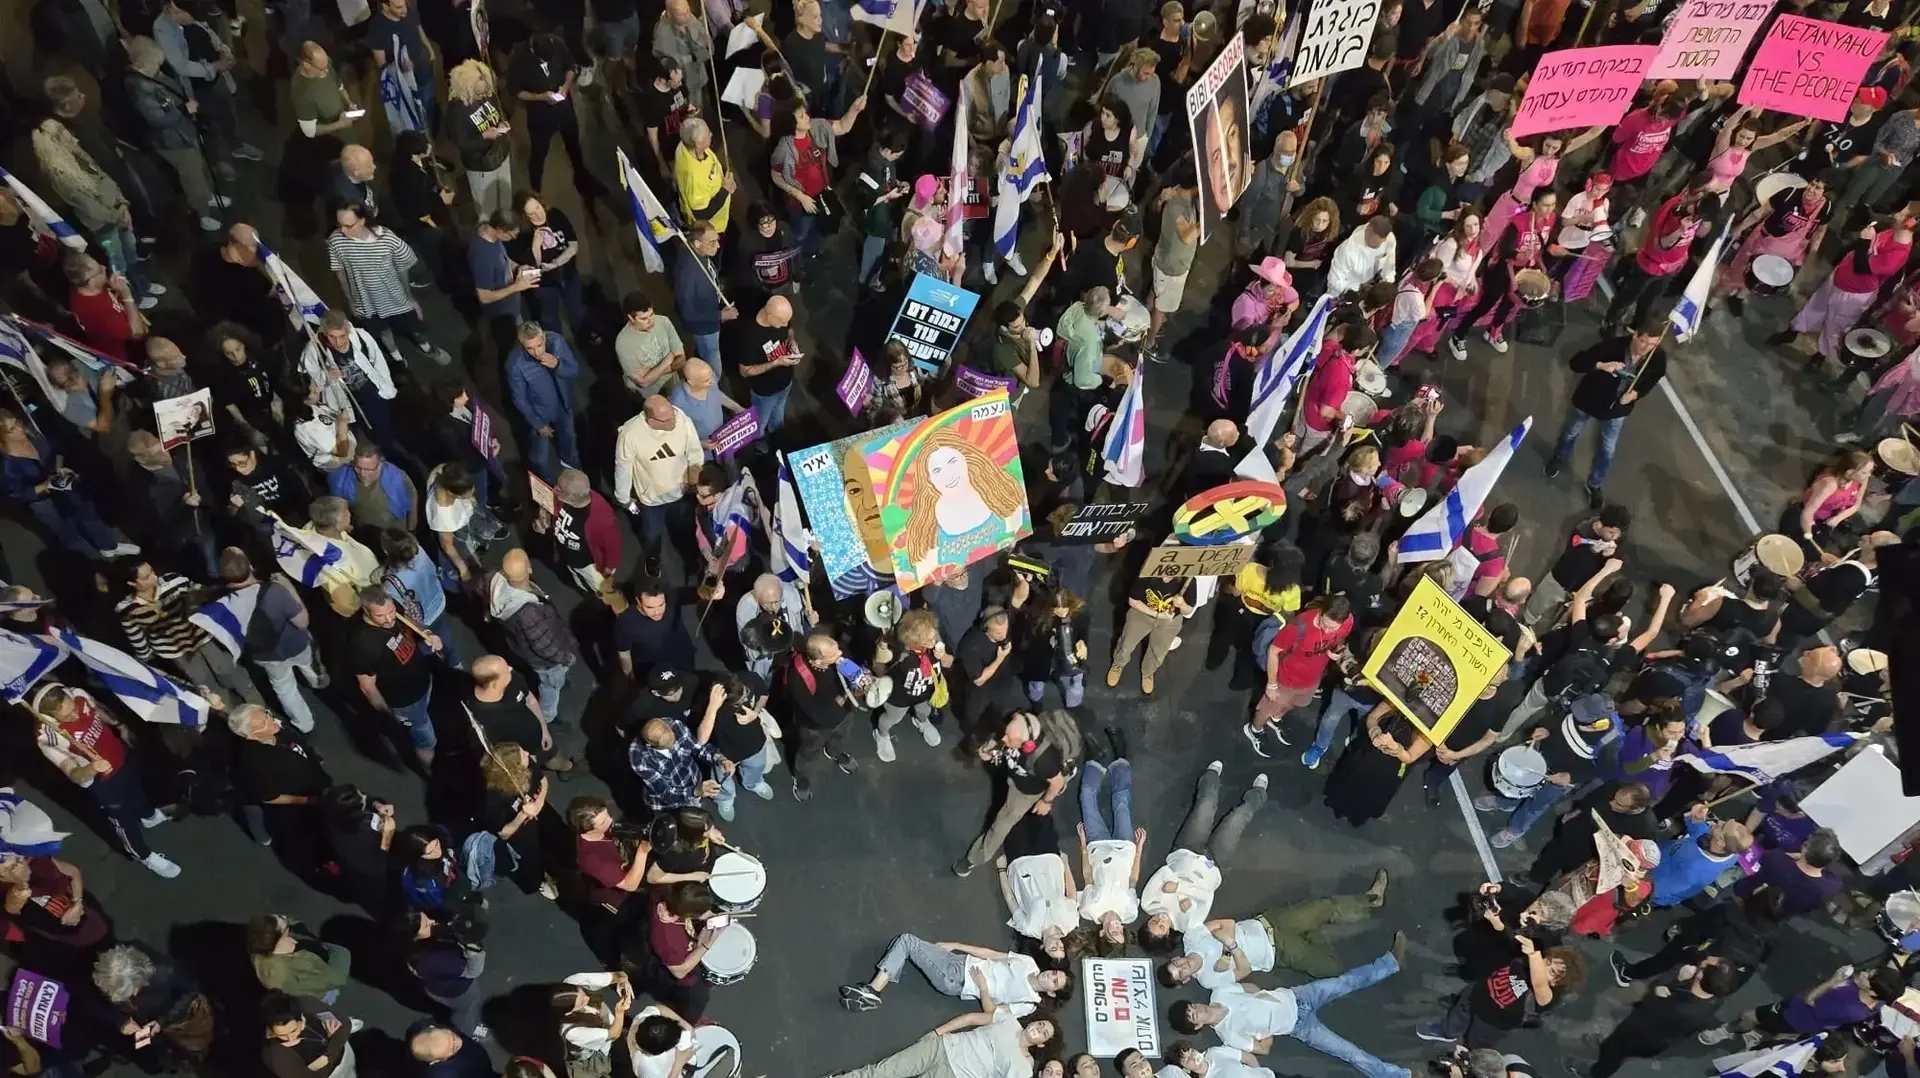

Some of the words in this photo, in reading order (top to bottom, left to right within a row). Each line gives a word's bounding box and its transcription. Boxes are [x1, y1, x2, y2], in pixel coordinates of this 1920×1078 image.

[1308, 2, 1376, 39] בוגדת
[1770, 19, 1882, 57] NETANYAHU
[1294, 34, 1364, 77] בעמה
[1797, 49, 1824, 73] VS.
[1189, 80, 1208, 116] BIBI
[1208, 36, 1242, 94] ESCOBAR
[1588, 58, 1643, 79] במקום
[1751, 67, 1791, 94] THE
[1791, 73, 1857, 104] PEOPLE
[1521, 88, 1575, 118] עסקה
[1823, 123, 1853, 151] 7.10
[906, 301, 930, 321] דם
[927, 309, 961, 332] כמה
[912, 323, 940, 344] עוד
[973, 402, 1004, 419] נעמה
[803, 453, 829, 472] יאיר
[1123, 502, 1148, 518] רק
[1160, 550, 1178, 563] a
[1150, 563, 1195, 576] NOT
[1433, 596, 1452, 617] יהיה
[1452, 616, 1463, 630] מי
[1464, 627, 1494, 658] צופים
[1462, 645, 1488, 676] השורד
[1092, 963, 1108, 1022] החטופים
[1136, 1015, 1154, 1050] אותם
